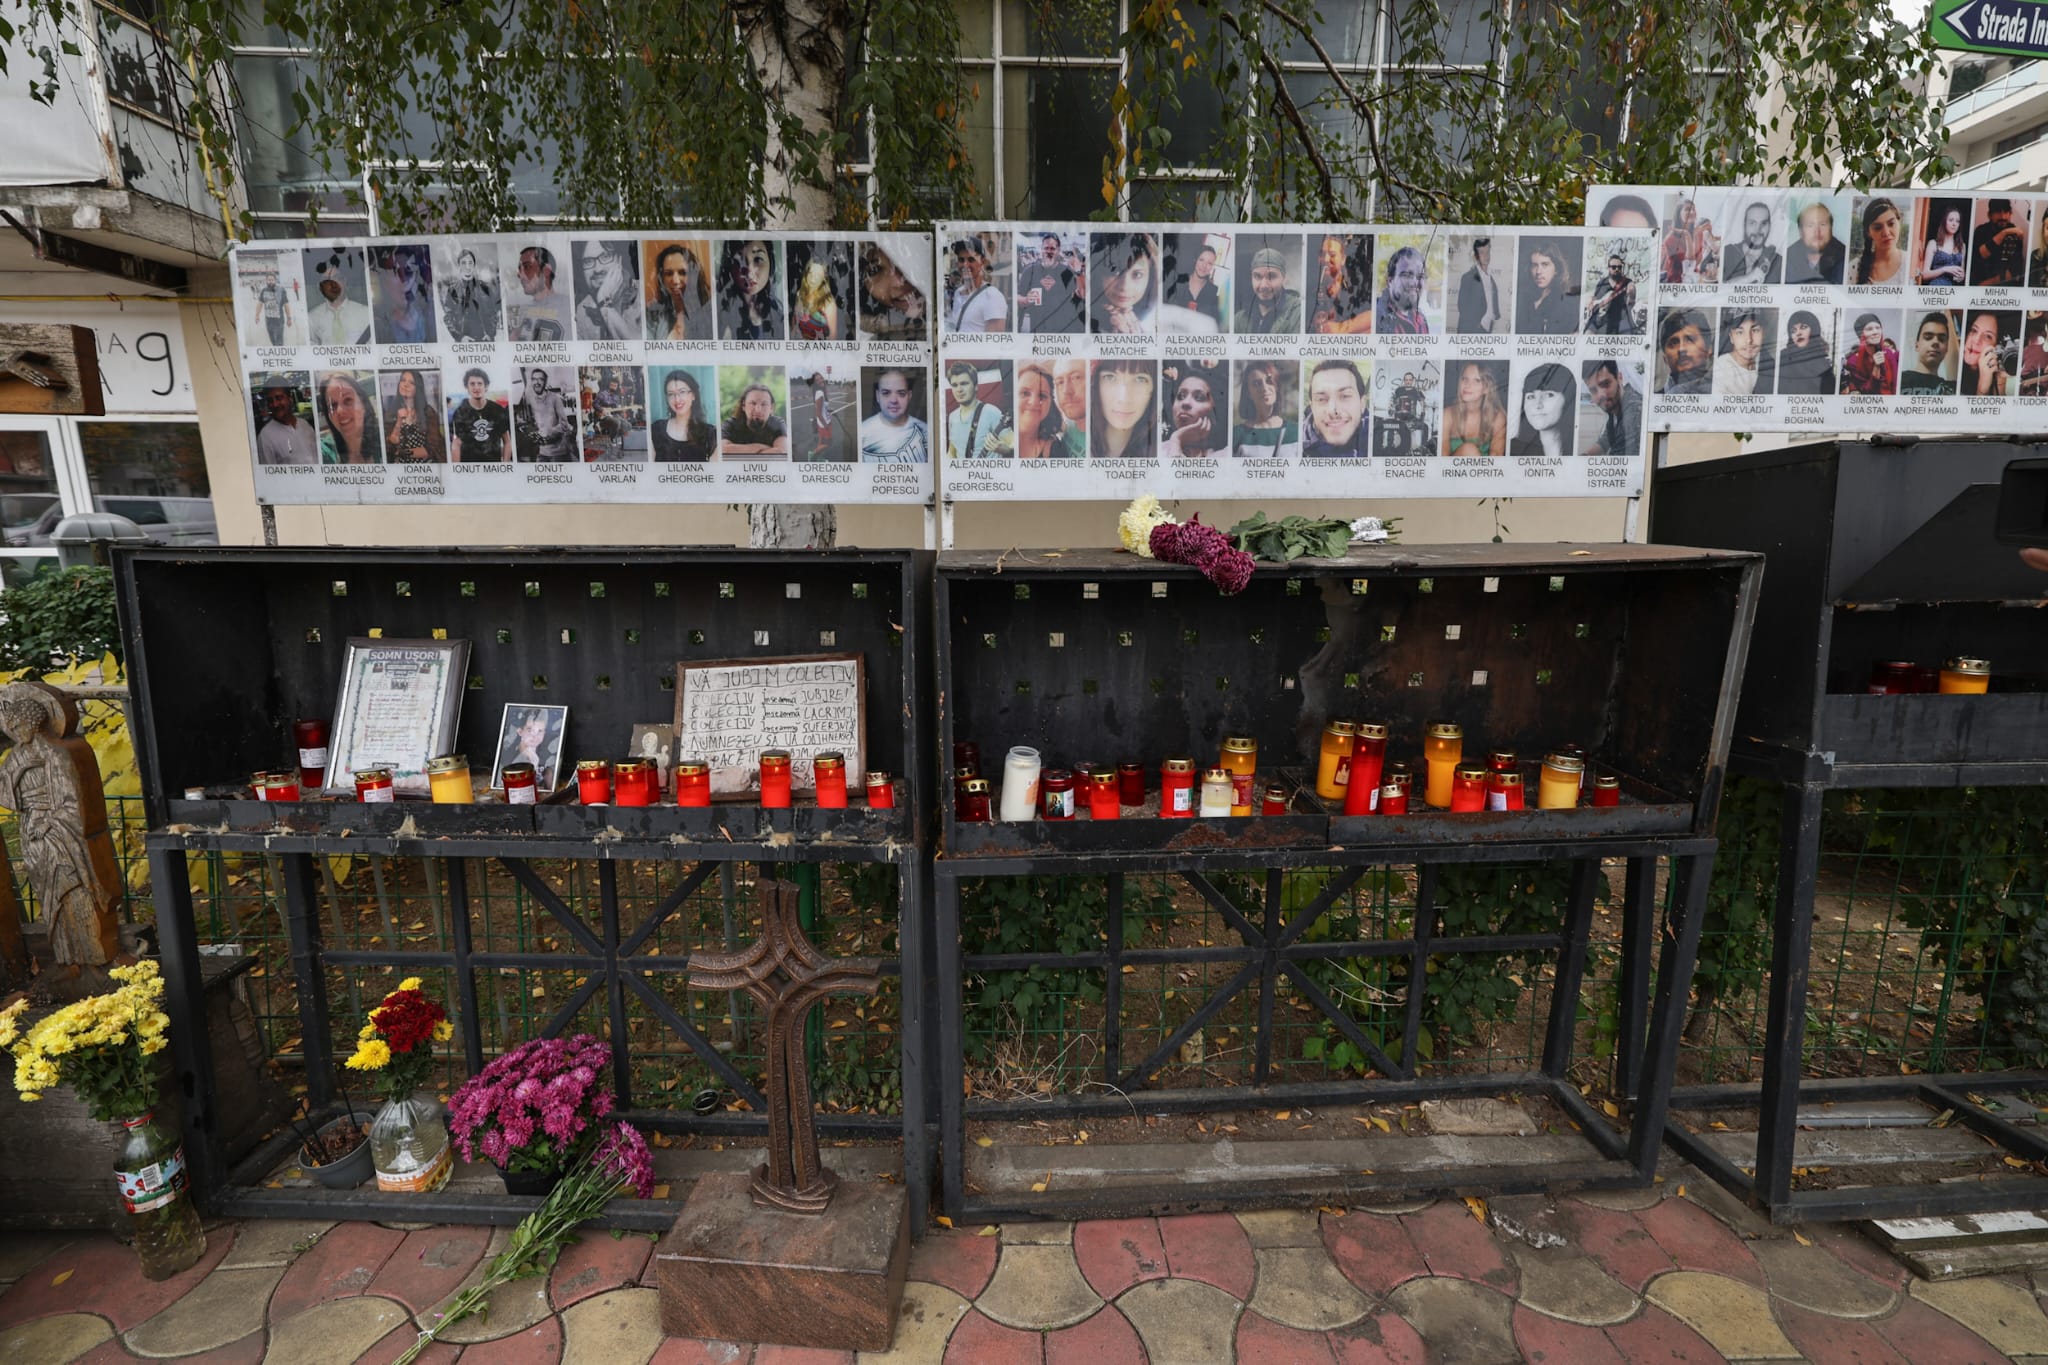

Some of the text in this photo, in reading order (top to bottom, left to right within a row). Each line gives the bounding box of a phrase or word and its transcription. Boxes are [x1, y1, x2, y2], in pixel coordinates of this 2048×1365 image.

[1977, 3, 2027, 43] Strada
[1688, 285, 1718, 294] VULCU
[1734, 285, 1768, 294] MARIUS
[1800, 286, 1826, 294] MATEI
[1848, 286, 1869, 295] MAVI
[1918, 287, 1955, 296] MIHAELA
[1985, 288, 2008, 296] MIHAI
[1794, 296, 1831, 305] GABRIEL
[1922, 297, 1949, 306] VIERU
[1970, 298, 2021, 307] ALEXANDRU
[944, 334, 1013, 343] ADRIAN POPA
[1032, 335, 1070, 344] ADRIAN
[1093, 335, 1154, 345] ALEXANDRA
[1165, 335, 1226, 345] ALEXANDRA
[1237, 335, 1298, 345] ALEXANDRU
[1308, 335, 1368, 345] ALEXANDRU
[1379, 335, 1439, 345] ALEXANDRU
[1449, 336, 1508, 345] ALEXANDRU
[1517, 336, 1576, 345] ALEXANDRU
[1586, 336, 1643, 346] ALEXANDRU
[389, 345, 426, 354] COSTEL
[452, 344, 496, 353] CRISTIAN
[515, 343, 567, 352] DAN MATEI
[592, 342, 627, 351] DANIEL
[644, 341, 717, 351] DIANA ENACHE
[723, 341, 781, 351] ELENA NITU
[785, 342, 860, 351] ELSA ANA ALBU
[868, 343, 919, 352] MADALINA
[256, 347, 297, 356] CLAUDIU
[312, 346, 371, 356] CONSTANTIN
[1032, 346, 1071, 356] RUGINA
[1100, 347, 1147, 356] MATACHE
[1165, 346, 1227, 356] RADULESCU
[1248, 347, 1286, 356] ALIMAN
[1299, 347, 1376, 356] CATALIN SIMION
[1389, 347, 1428, 357] CHELBA
[1460, 347, 1496, 356] HOGEA
[1517, 347, 1576, 356] MIHAI IANCU
[1598, 348, 1630, 356] PASCU
[329, 357, 356, 366] IGNAT
[382, 356, 435, 366] CARLICEAN
[458, 355, 491, 364] MITROI
[513, 354, 571, 364] ALEXANDRU
[589, 353, 633, 362] CIOBANU
[866, 354, 922, 363] STRUGARU
[263, 358, 293, 367] PETRE
[1664, 395, 1700, 403] RAZVAN
[1723, 395, 1766, 404] ROBERTO
[1787, 396, 1824, 404] ROXANA
[1850, 396, 1884, 404] SIMONA
[1910, 397, 1944, 405] STEFAN
[1967, 397, 2006, 405] TEODORA
[2019, 398, 2047, 406] TUDOR
[1654, 405, 1709, 414] SOROCEANU
[1713, 405, 1774, 414] ANDY VLADUT
[1791, 406, 1819, 415] ELENA
[1844, 406, 1888, 415] LIVIA STAN
[1894, 406, 1958, 415] ANDREI HAMAD
[1970, 407, 2001, 415] MAFTEI
[1784, 416, 1824, 425] BOGHIAN
[949, 460, 1011, 469] ALEXANDRU
[1020, 459, 1085, 469] ANDA EPURE
[1090, 459, 1160, 468] ANDRA ELENA
[1170, 459, 1219, 468] ANDREEA
[1242, 459, 1290, 468] ANDREEA
[1299, 458, 1371, 467] AYBERK MANCI
[1384, 458, 1426, 467] BOGDAN
[1453, 458, 1494, 467] CARMEN
[1518, 457, 1563, 466] CATALINA
[1587, 457, 1629, 466] CLAUDIU
[264, 466, 315, 475] IOAN TRIPA
[321, 465, 387, 474] IOANA RALUCA
[404, 465, 432, 473] IOANA
[452, 464, 514, 473] IONUT MAIOR
[534, 464, 564, 473] IONUT
[590, 464, 644, 473] LAURENTIU
[667, 464, 705, 472] LILIANA
[743, 464, 768, 472] LIVIU
[798, 464, 853, 473] LOREDANA
[877, 464, 914, 473] FLORIN
[1524, 468, 1555, 477] IONITA
[1587, 468, 1628, 477] BOGDAN
[968, 471, 994, 480] PAUL
[1106, 470, 1146, 480] TOADER
[1174, 470, 1216, 479] CHIRIAC
[1247, 470, 1285, 479] STEFAN
[1385, 469, 1425, 478] ENACHE
[1442, 468, 1504, 478] IRINA OPRITA
[324, 476, 385, 485] PANCULESCU
[397, 475, 441, 485] VICTORIA
[527, 475, 573, 484] POPESCU
[598, 474, 636, 484] VARLAN
[658, 474, 715, 484] GHEORGHE
[725, 474, 786, 484] ZAHARESCU
[802, 474, 850, 484] DARESCU
[872, 474, 919, 484] CRISTIAN
[1588, 479, 1626, 488] ISTRATE
[394, 487, 445, 496] GEAMBASU
[872, 486, 920, 495] POPESCU
[948, 482, 1013, 492] GEORGESCU
[370, 651, 401, 660] SOMN
